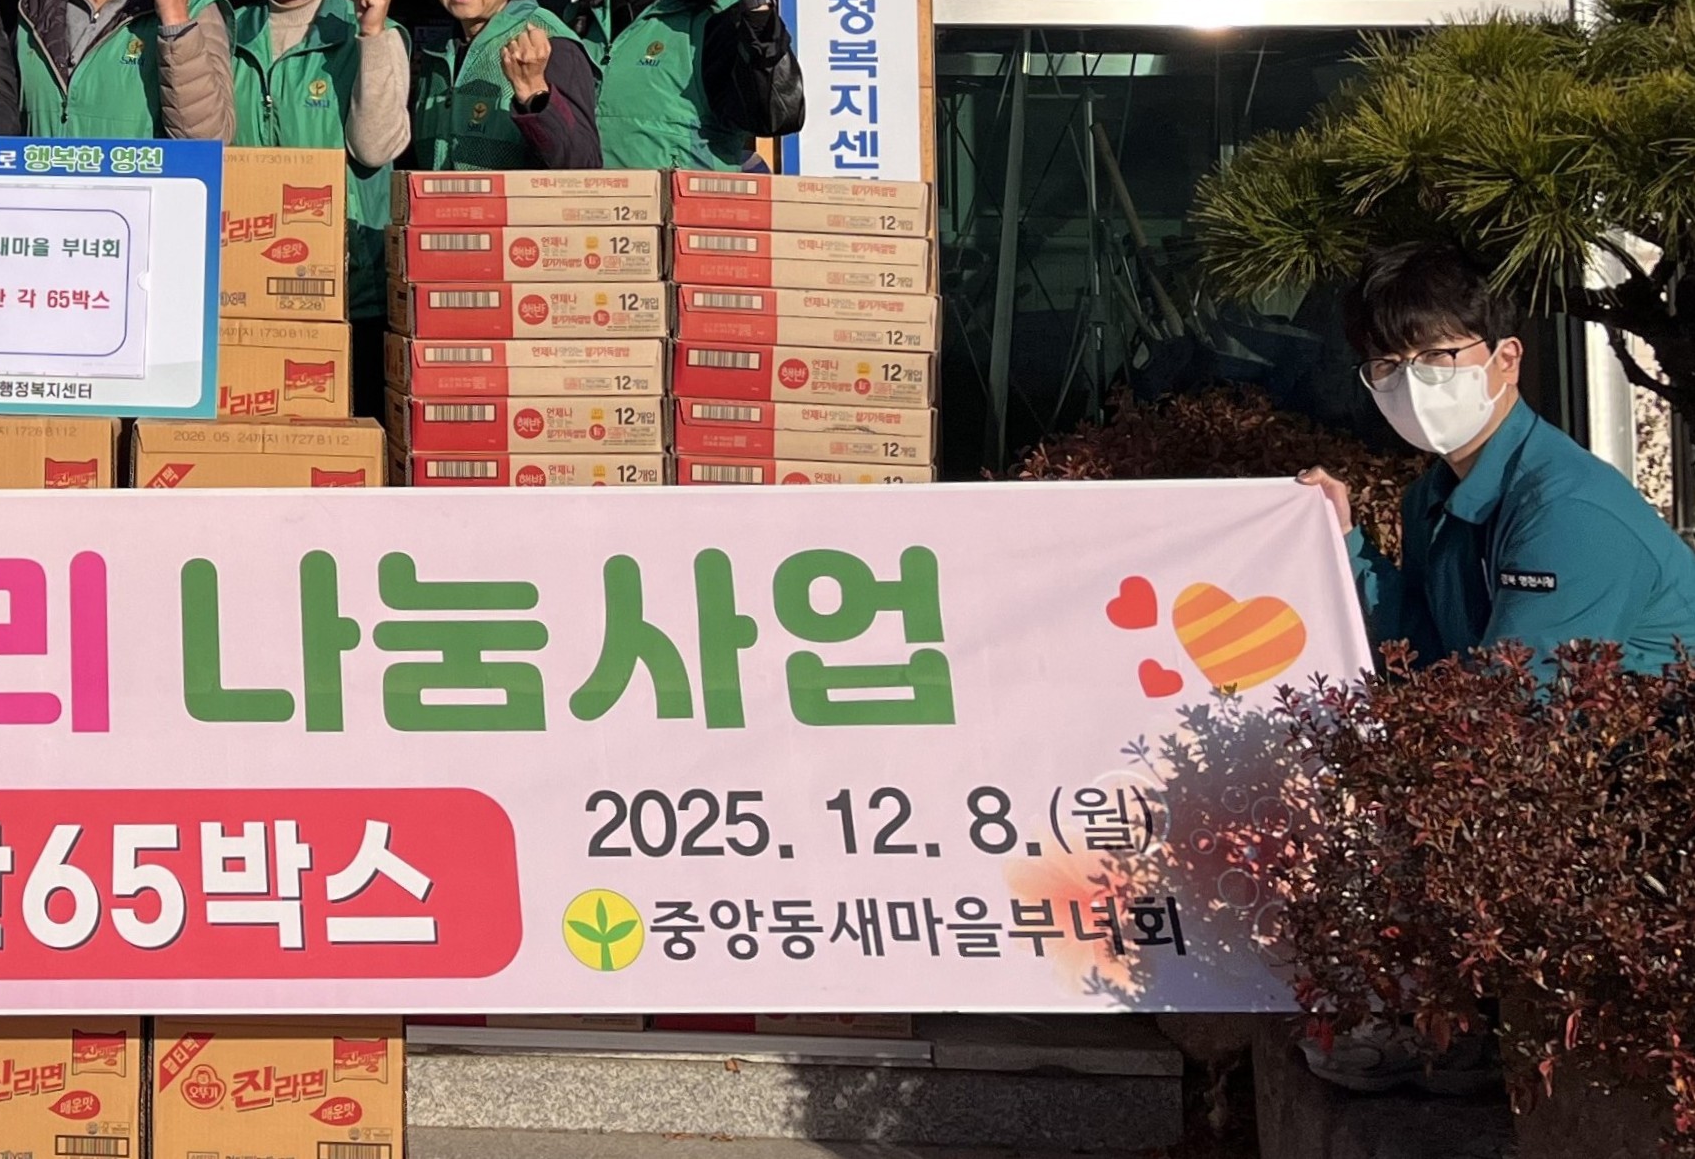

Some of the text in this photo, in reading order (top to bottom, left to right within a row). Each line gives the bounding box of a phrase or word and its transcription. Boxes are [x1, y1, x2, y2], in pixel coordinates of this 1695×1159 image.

[24, 146, 103, 172] 행복한
[110, 146, 163, 173] 영천
[531, 177, 557, 188] 언제나
[798, 182, 823, 193] 언제나
[613, 206, 648, 221] 12개입
[879, 215, 913, 231] 12개입
[62, 238, 120, 259] 부녀회
[541, 237, 568, 248] 언제나
[609, 237, 650, 254] 12개입
[798, 239, 823, 251] 언제나
[512, 245, 537, 260] 햇반
[879, 273, 913, 288] 12개입
[18, 289, 36, 308] 각
[47, 290, 110, 310] 65박스
[550, 294, 577, 304] 언제나
[619, 293, 659, 311] 12개입
[804, 296, 830, 307] 언제나
[521, 303, 546, 318] 햇반
[886, 330, 920, 346] 12개입
[532, 347, 558, 357] 언제나
[812, 360, 838, 370] 언제나
[782, 366, 805, 381] 햇반
[882, 364, 922, 382] 12개입
[614, 375, 649, 390] 12개입
[547, 408, 572, 418] 언제나
[615, 408, 655, 425] 12개입
[802, 409, 828, 420] 언제나
[517, 416, 541, 432] 햇반
[882, 443, 916, 457] 12개입
[548, 465, 575, 476] 언제나
[617, 465, 657, 483] 12개입
[180, 545, 957, 734] 나눔사업
[585, 789, 795, 859] 2025.
[826, 787, 942, 858] 12.
[650, 895, 1188, 960] 중앙동새마을부녀회
[189, 1086, 219, 1099] 오뚜기
[231, 1066, 327, 1112] 진라면
[60, 1097, 93, 1114] 매운맛
[321, 1103, 356, 1120] 매운맛
